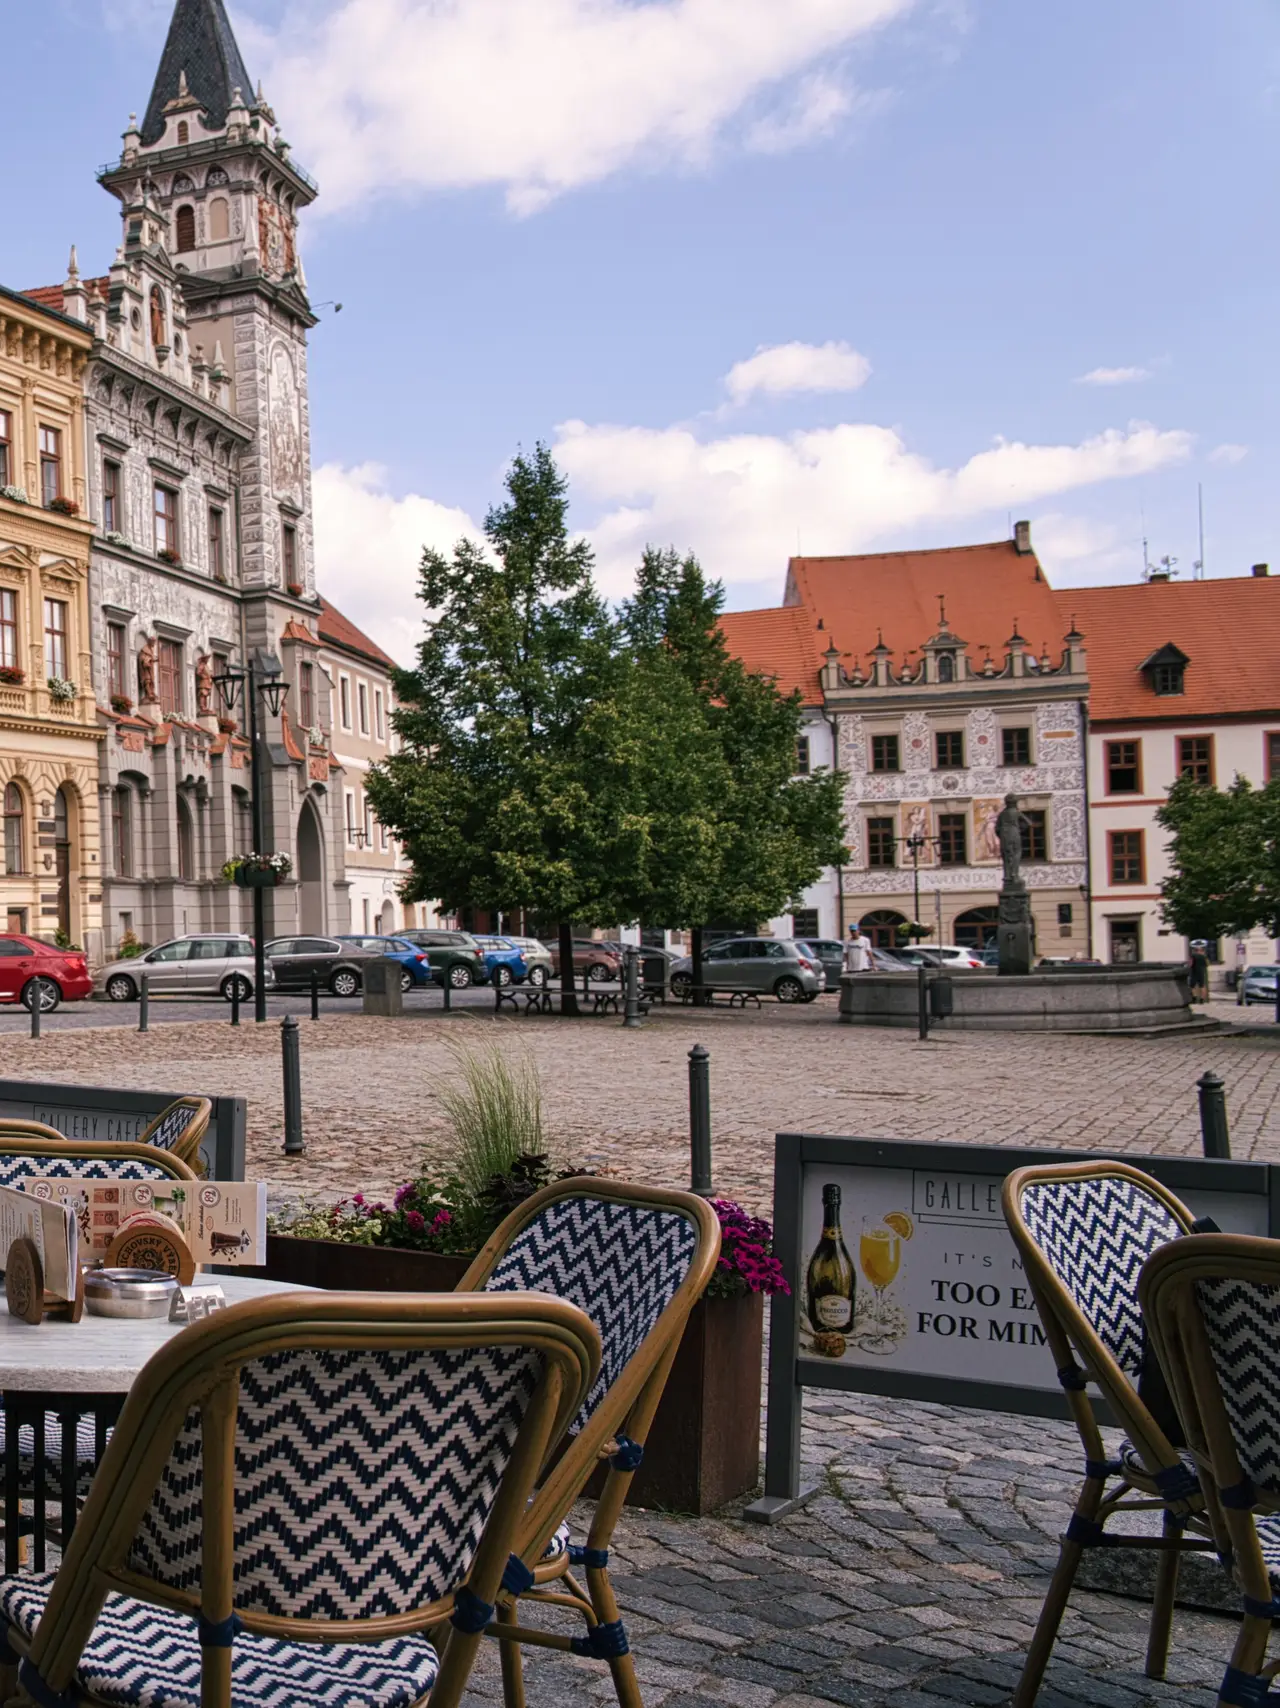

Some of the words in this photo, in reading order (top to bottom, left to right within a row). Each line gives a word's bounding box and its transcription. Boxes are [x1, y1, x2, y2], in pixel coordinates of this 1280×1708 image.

[107, 1117, 141, 1142] CAFÉ
[925, 1180, 998, 1213] GALLE
[944, 1252, 993, 1268] IT'S
[931, 1279, 1001, 1307] TOO
[916, 1311, 980, 1340] FOR
